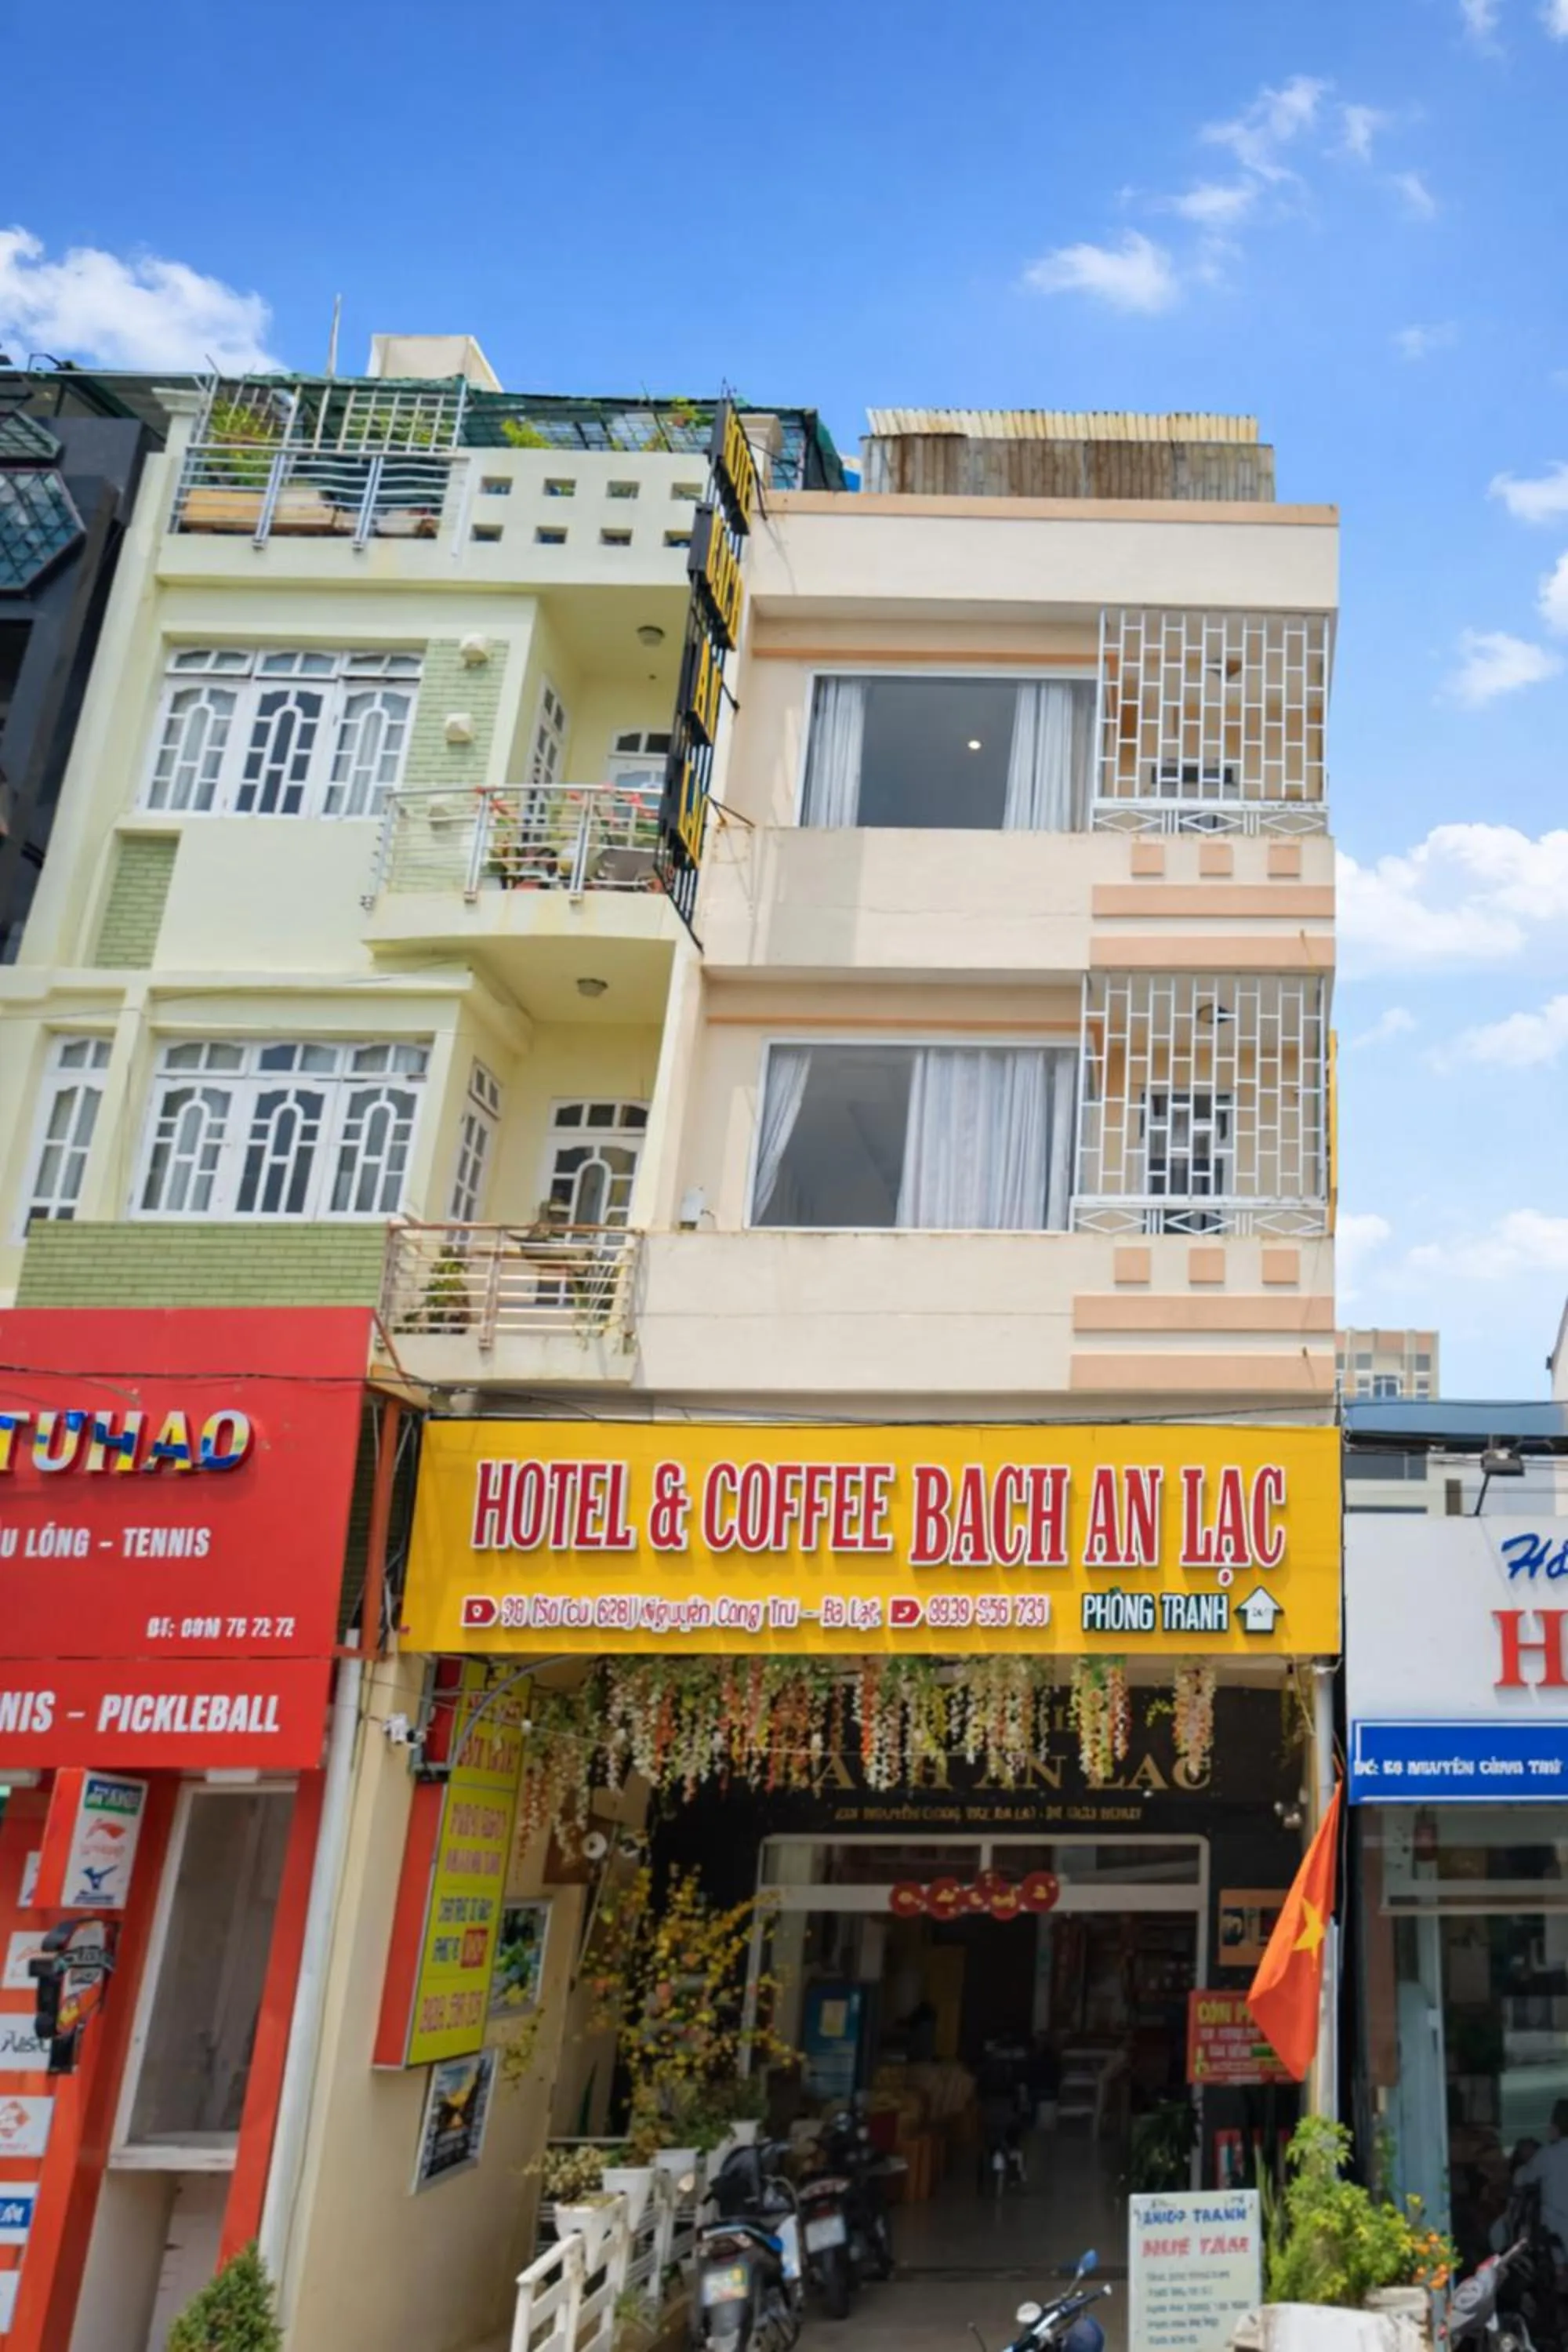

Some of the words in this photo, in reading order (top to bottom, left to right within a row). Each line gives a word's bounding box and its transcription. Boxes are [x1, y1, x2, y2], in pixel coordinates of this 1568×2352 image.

[471, 1458, 637, 1552] HOTEL
[646, 1460, 691, 1552] &
[702, 1461, 895, 1552] COFFEE
[907, 1463, 1071, 1566] BACH
[1081, 1464, 1165, 1567] AN
[1179, 1463, 1286, 1587] LẠC
[122, 1527, 211, 1558] TENNIS
[1162, 1592, 1229, 1632] TRANH
[96, 1694, 281, 1733] PICKLEBALL
